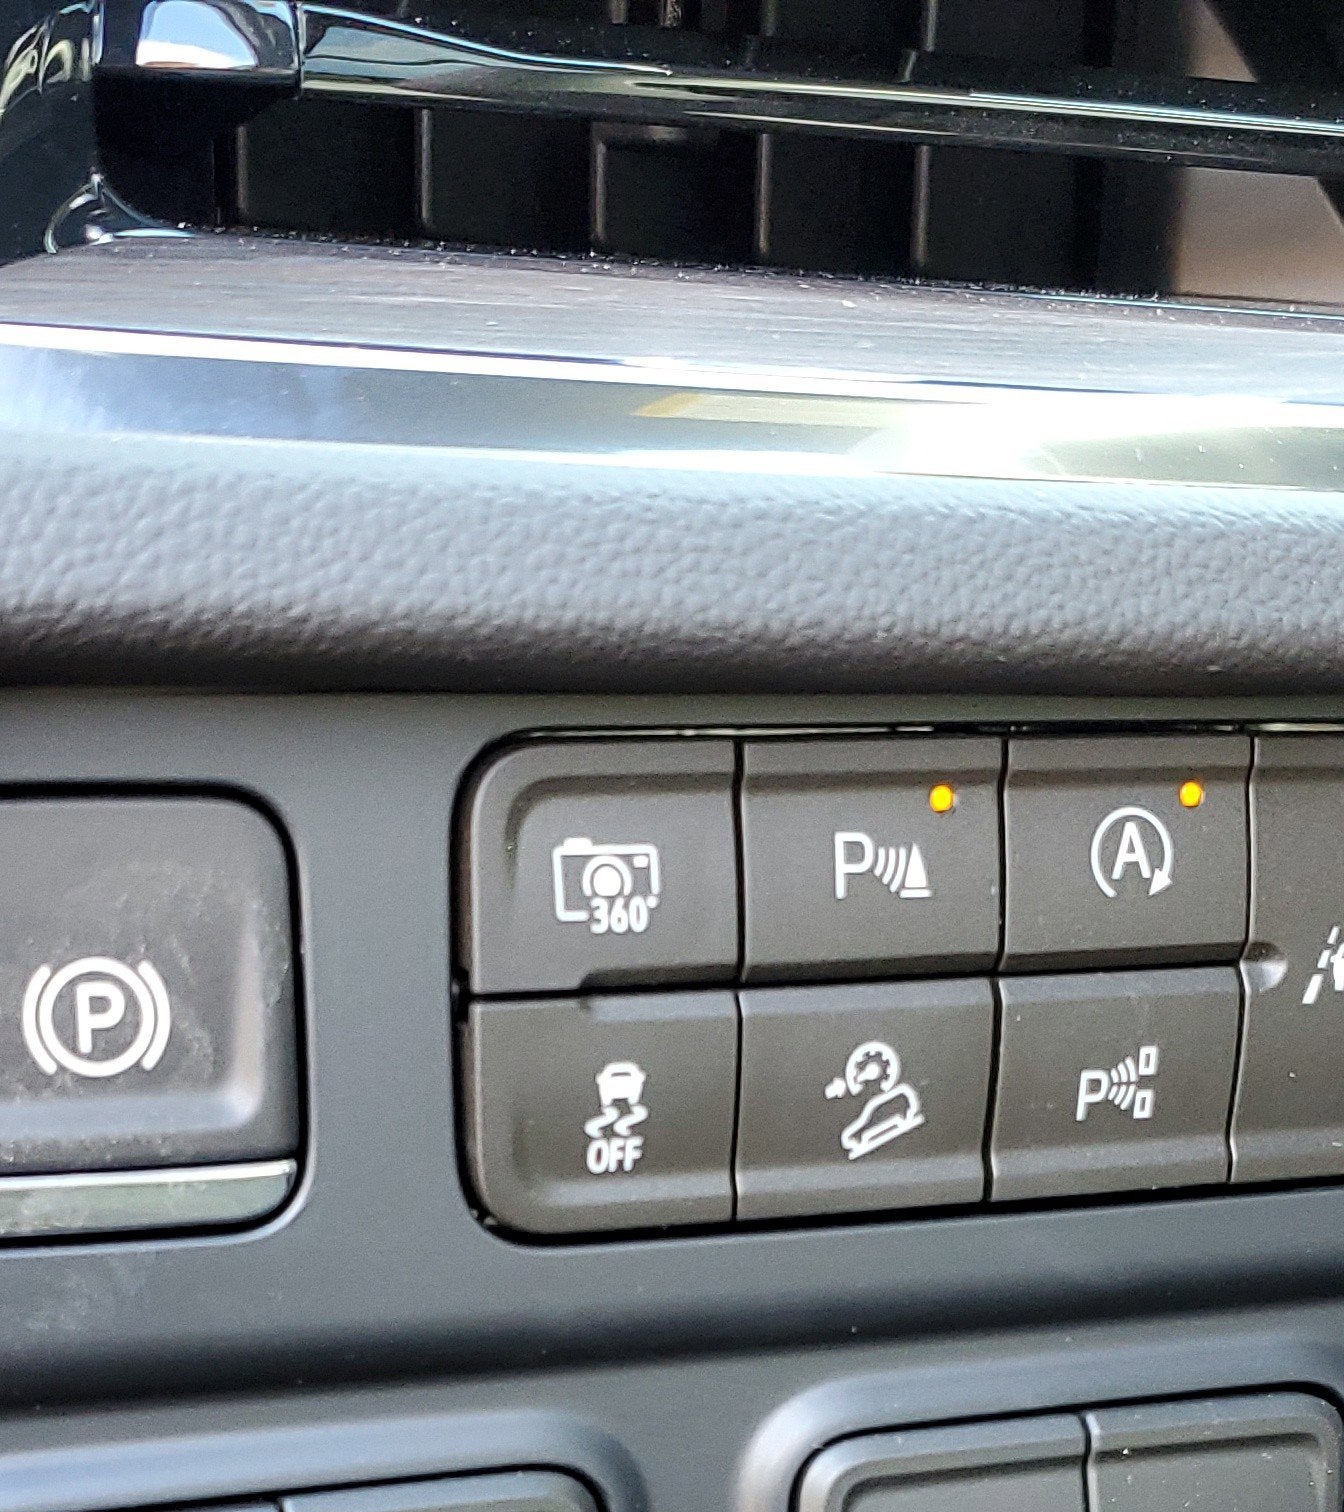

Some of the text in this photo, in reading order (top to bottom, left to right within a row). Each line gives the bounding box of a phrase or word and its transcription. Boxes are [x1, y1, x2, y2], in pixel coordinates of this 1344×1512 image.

[834, 832, 874, 900] P
[75, 981, 126, 1054] P
[1075, 1069, 1108, 1120] P
[586, 1137, 643, 1173] OFF
